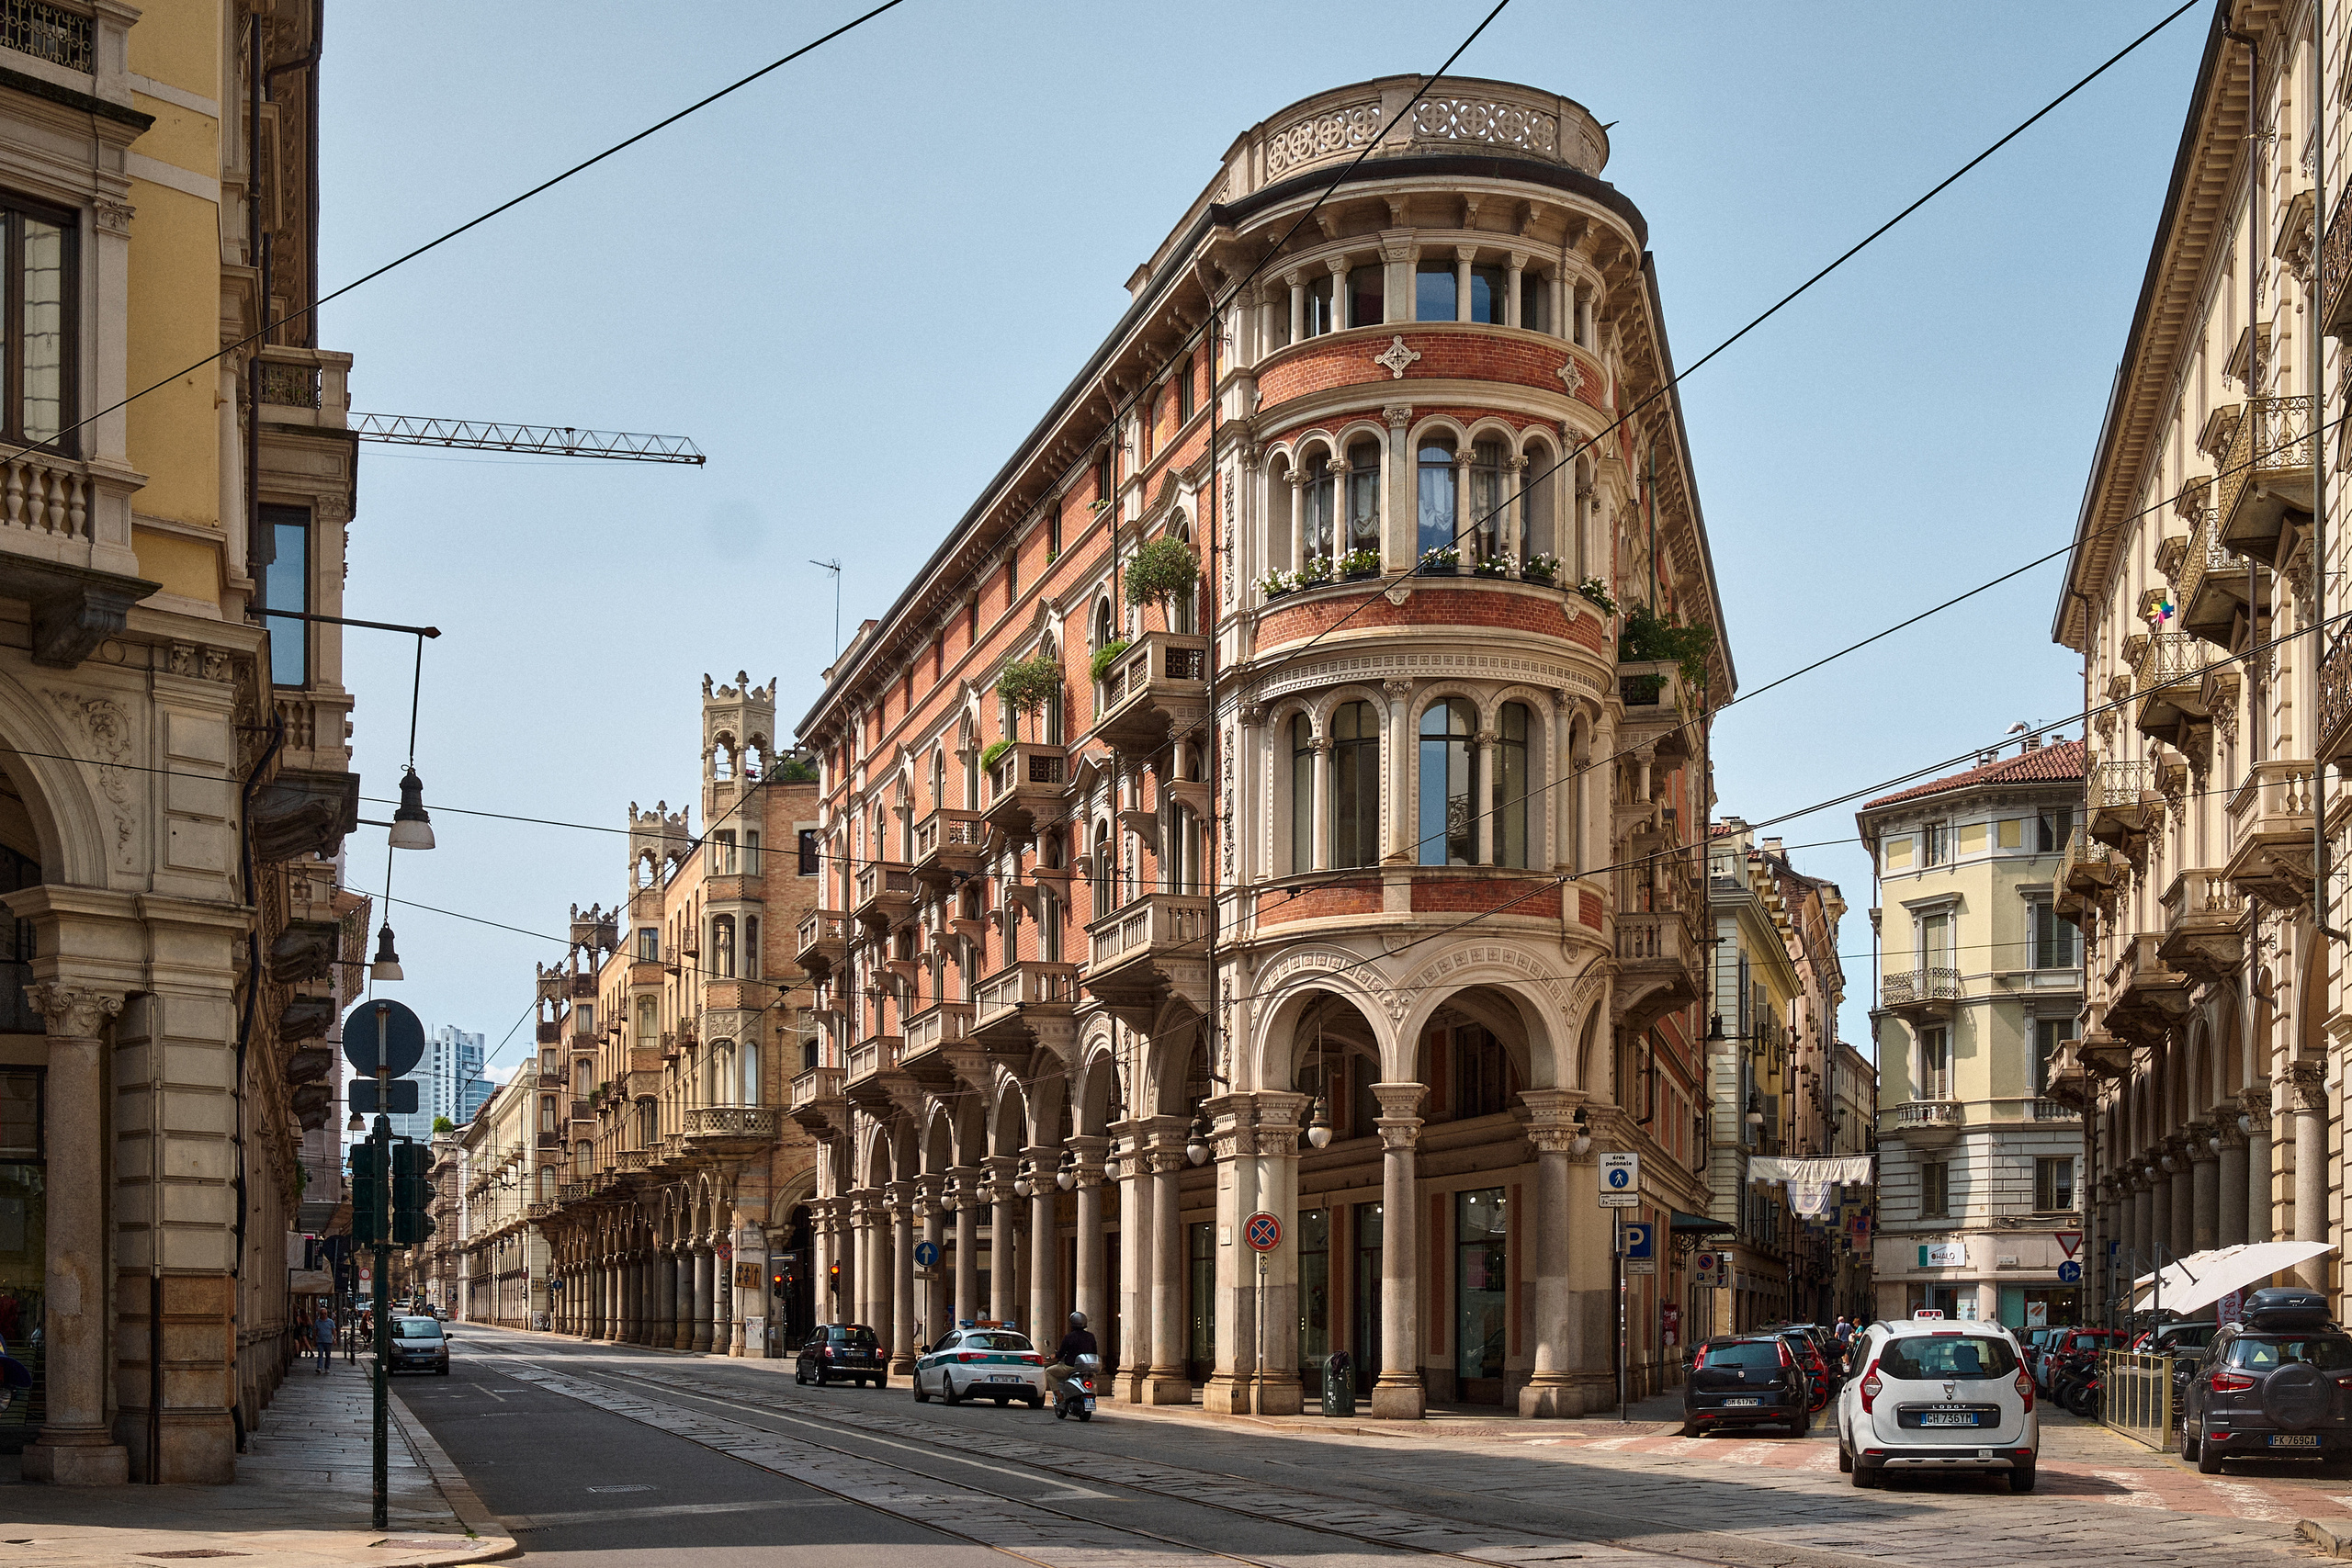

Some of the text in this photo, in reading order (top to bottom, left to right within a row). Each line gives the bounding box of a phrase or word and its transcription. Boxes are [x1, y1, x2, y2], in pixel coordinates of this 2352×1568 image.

[1625, 1227, 1645, 1255] P
[1927, 1413, 1972, 1424] GH 736YM
[2274, 1436, 2315, 1445] FK 769GA
